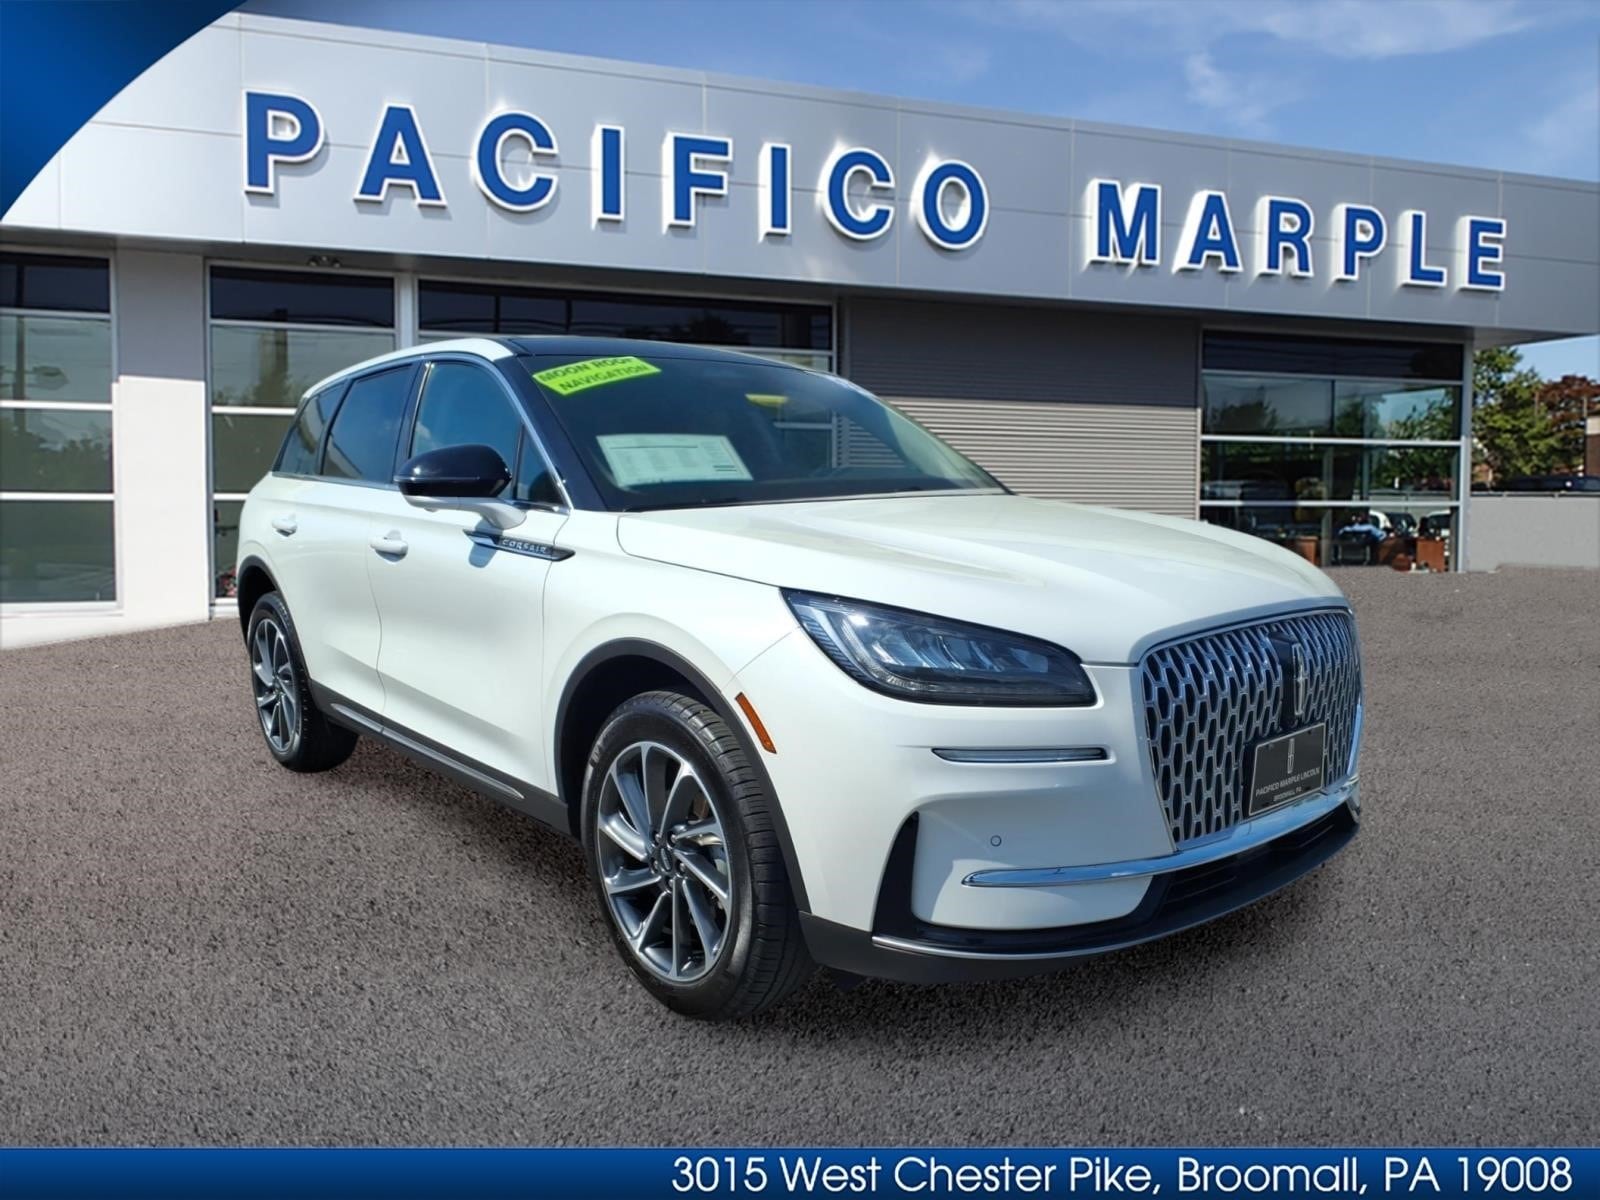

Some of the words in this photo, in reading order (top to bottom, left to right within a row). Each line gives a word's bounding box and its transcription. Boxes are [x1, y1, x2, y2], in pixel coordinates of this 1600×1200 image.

[241, 89, 990, 250] PACIFICO
[1086, 178, 1507, 293] MARPLE
[538, 362, 591, 382] MOON
[558, 363, 650, 391] NAVIGATION
[502, 539, 548, 553] CORSAIR
